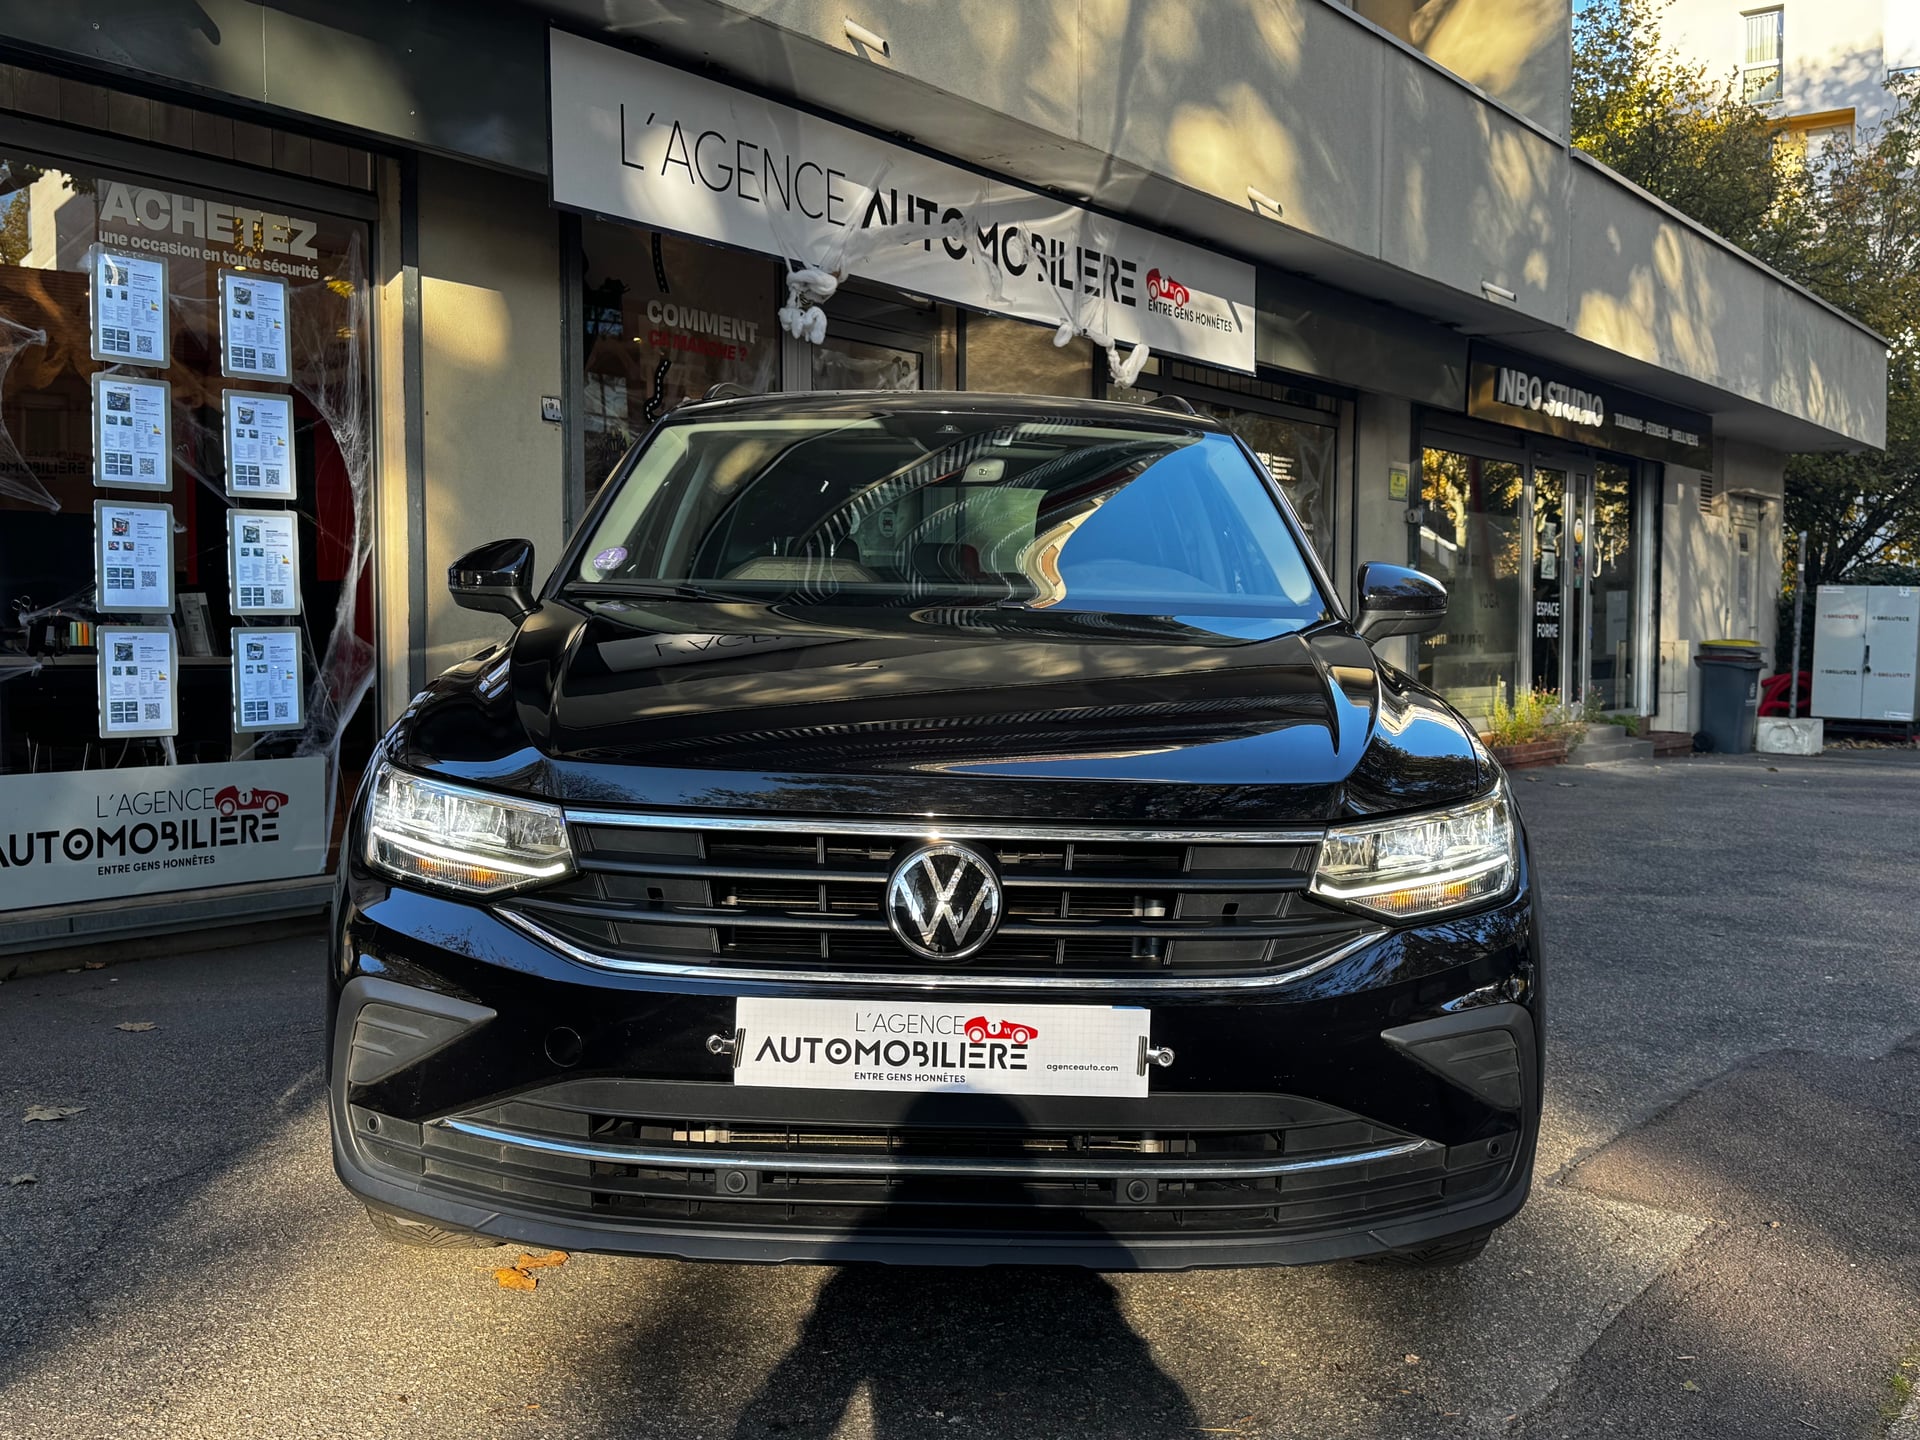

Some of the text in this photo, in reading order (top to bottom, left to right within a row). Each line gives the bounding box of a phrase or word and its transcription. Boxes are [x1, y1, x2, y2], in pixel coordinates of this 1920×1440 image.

[100, 180, 318, 260] ACHETEZ
[99, 230, 319, 279] une occasion en toute sécurité
[647, 300, 759, 345] COMMENT
[1148, 299, 1232, 333] ENTRE GENS HONNÊTES
[1498, 367, 1604, 428] NBO STUDIO
[1536, 601, 1560, 617] ESPACE
[1536, 623, 1559, 638] FORME
[96, 787, 215, 818] L'AGENCE
[0, 812, 280, 868] UTOMOBILIERE
[98, 854, 216, 876] ENTRE GENS HONNÊTES
[855, 1012, 965, 1036] L'AGENCE
[854, 1071, 966, 1084] ENTRE GENS HONNÊTES
[1046, 1062, 1119, 1073] agenceauto.com
